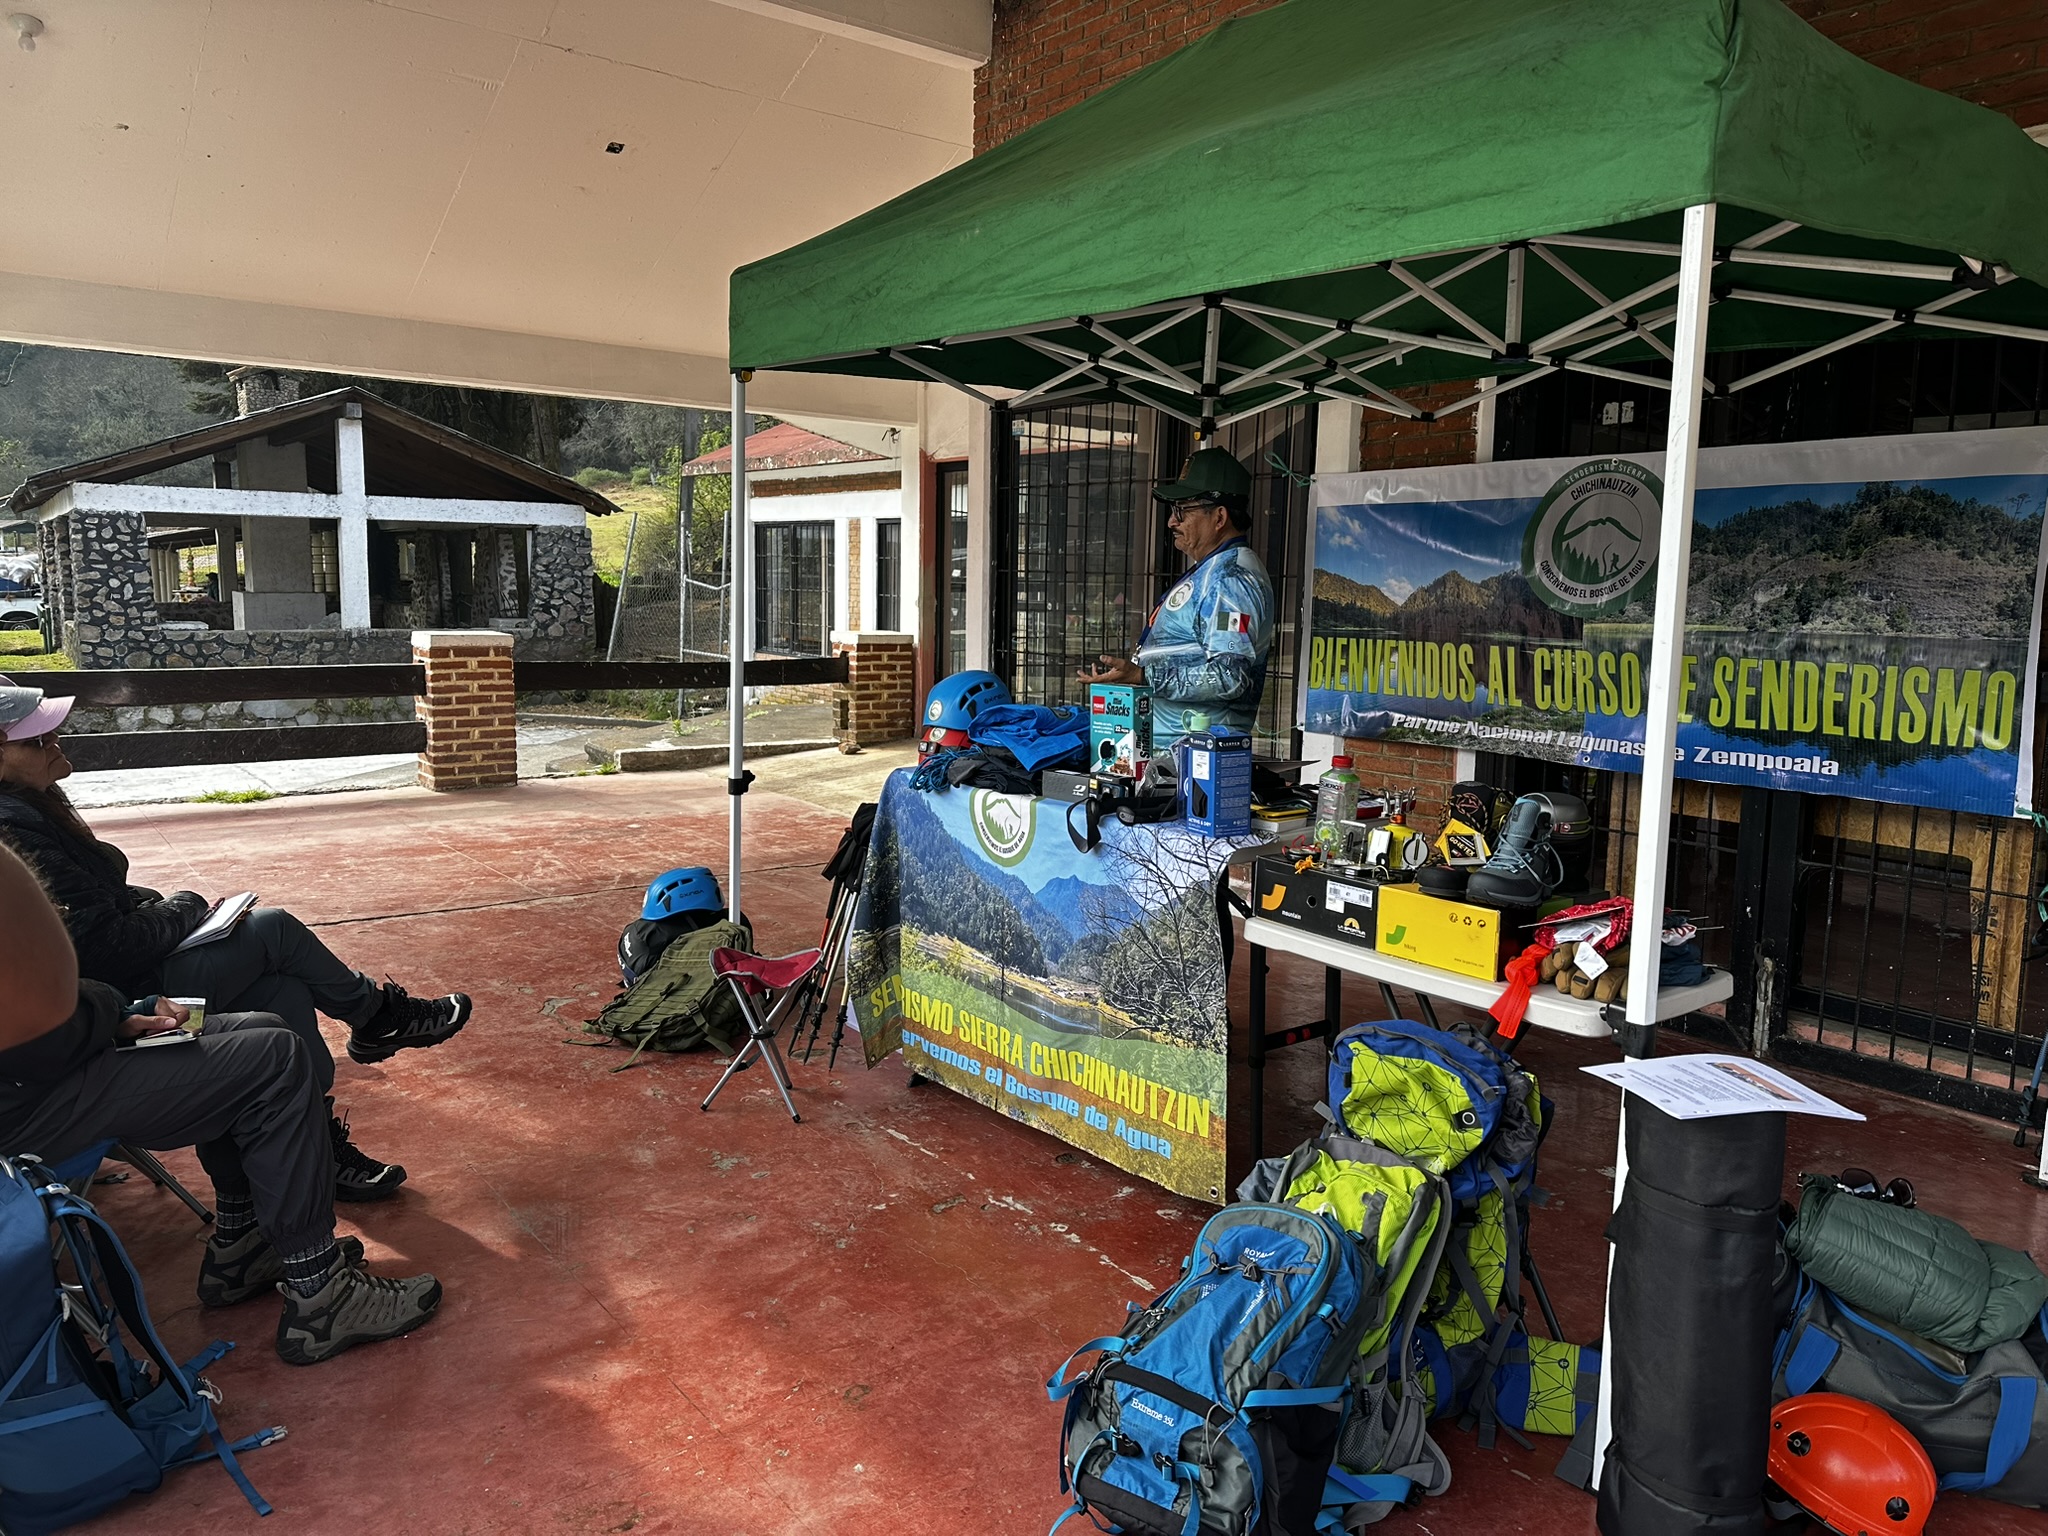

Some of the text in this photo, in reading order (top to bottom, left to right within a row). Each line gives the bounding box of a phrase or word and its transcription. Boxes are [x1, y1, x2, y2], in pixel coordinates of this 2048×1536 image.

[1564, 463, 1647, 486] SENDERISMO SIERRA
[1570, 477, 1640, 501] CHICHINAUTZIN
[1540, 559, 1647, 599] CONSERVEMOS EL BOSQUE DE AGUA
[1106, 702, 1131, 717] Snacks
[1310, 636, 1477, 703] BIENVENIDOS
[1487, 645, 1522, 707] AL
[1533, 647, 1641, 718] CURSO
[1677, 655, 1698, 724] E
[1708, 656, 2016, 750] SENDERISMO
[1139, 721, 1150, 759] Snacks
[1392, 713, 1839, 775] Parque Nacional Lagunas e Zempoala
[1449, 836, 1476, 857] GORE-TEX
[959, 1009, 1024, 1070] SIERRA
[1029, 1041, 1210, 1139] CHICHINAUTZIN
[985, 1064, 1003, 1087] el
[1004, 1073, 1080, 1118] Bosque
[1084, 1105, 1108, 1131] de
[1114, 1117, 1172, 1160] Agua
[1130, 1397, 1175, 1427] Extreme 35L
